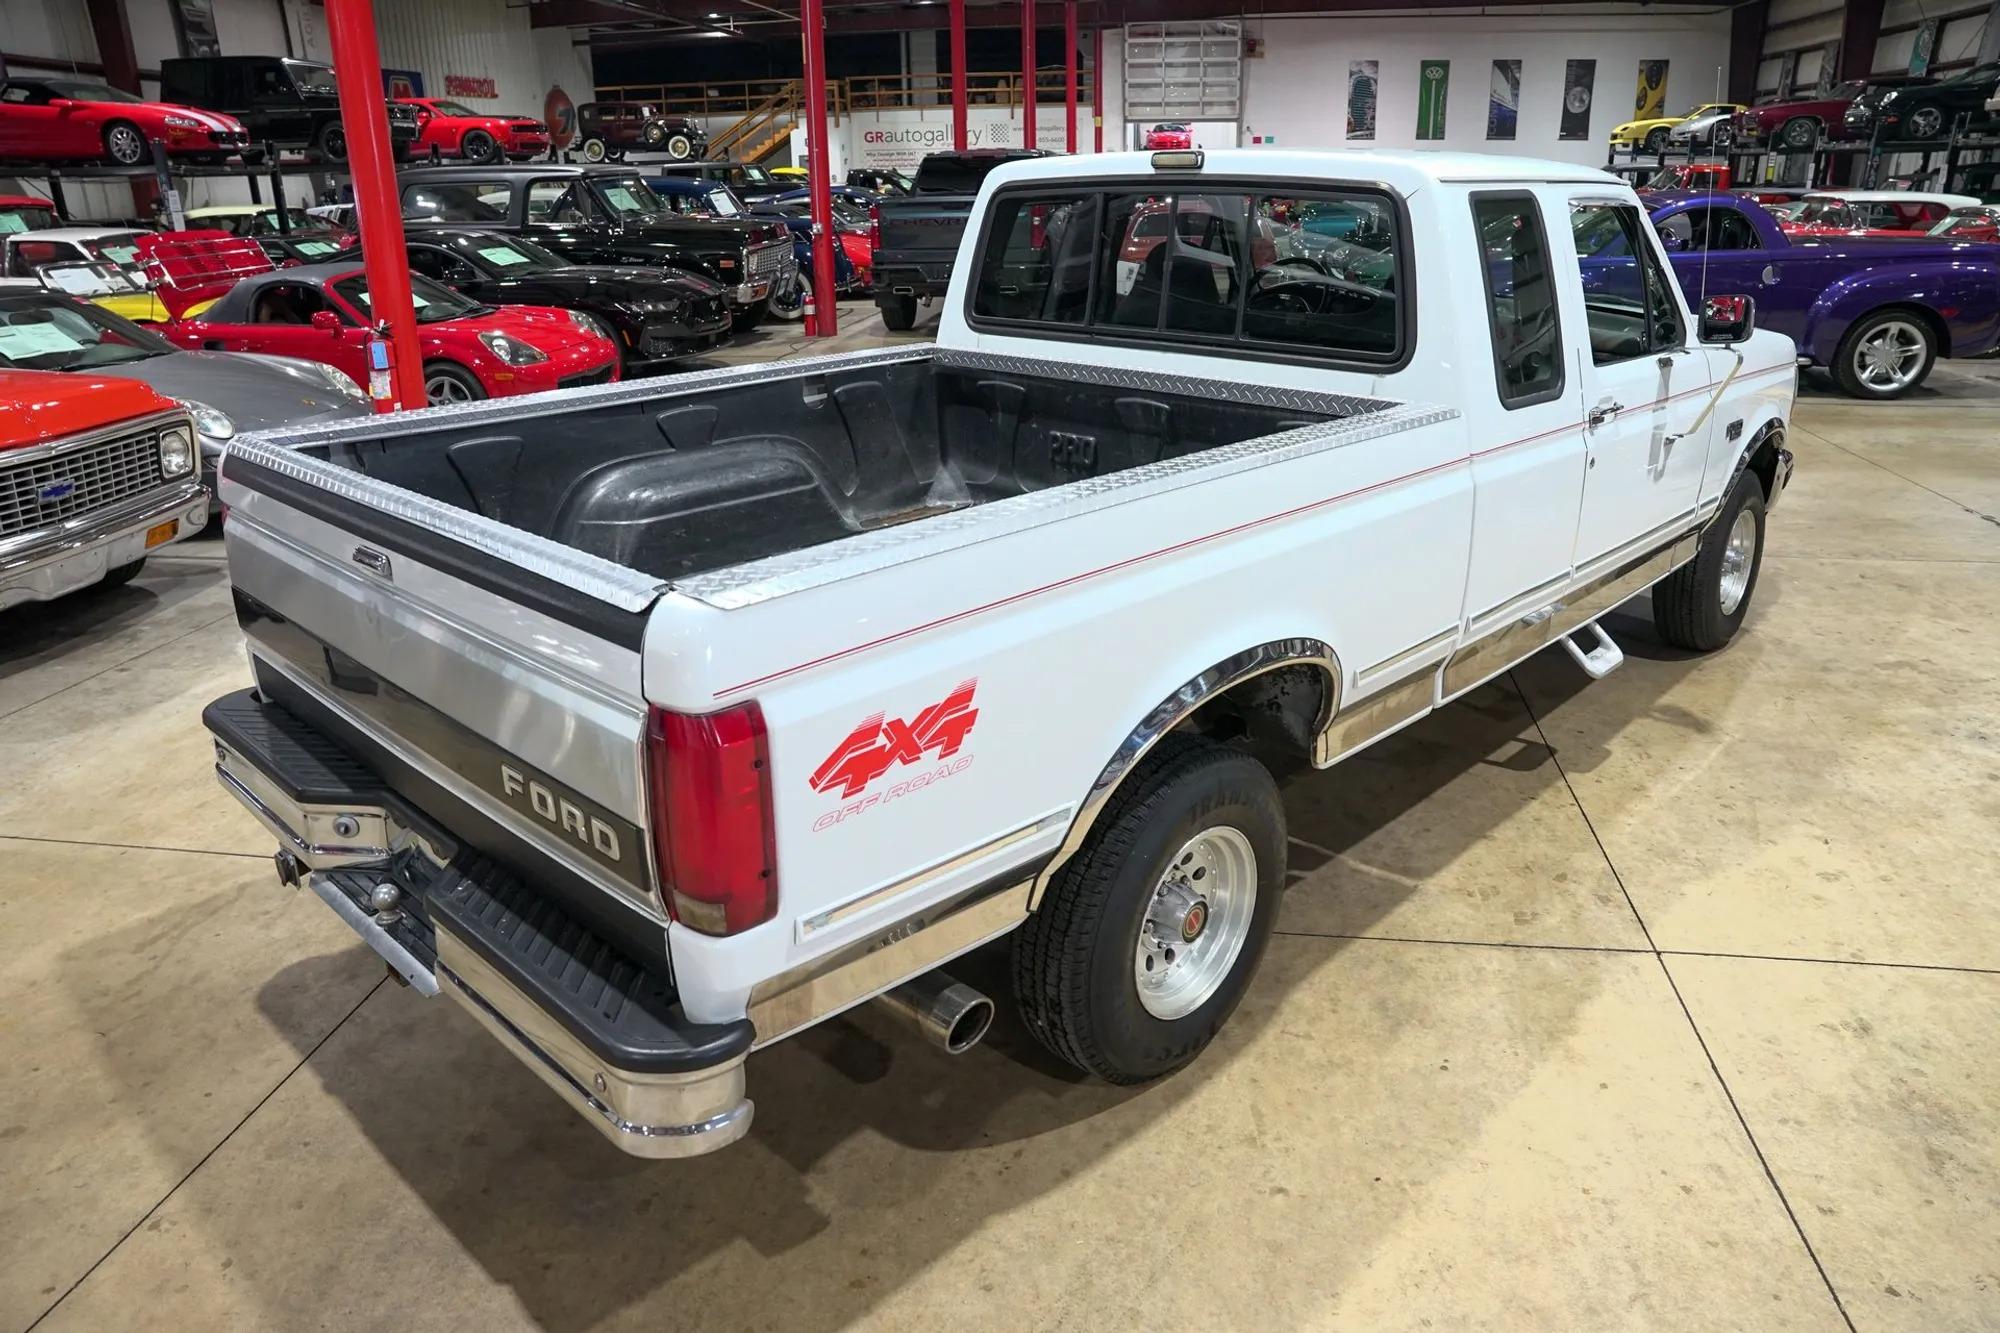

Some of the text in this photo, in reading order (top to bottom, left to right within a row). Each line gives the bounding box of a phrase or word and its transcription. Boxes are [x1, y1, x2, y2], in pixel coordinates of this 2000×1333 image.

[864, 124, 982, 146] GRautogallry
[501, 764, 620, 861] FORD
[813, 754, 974, 832] OFF ROAD
